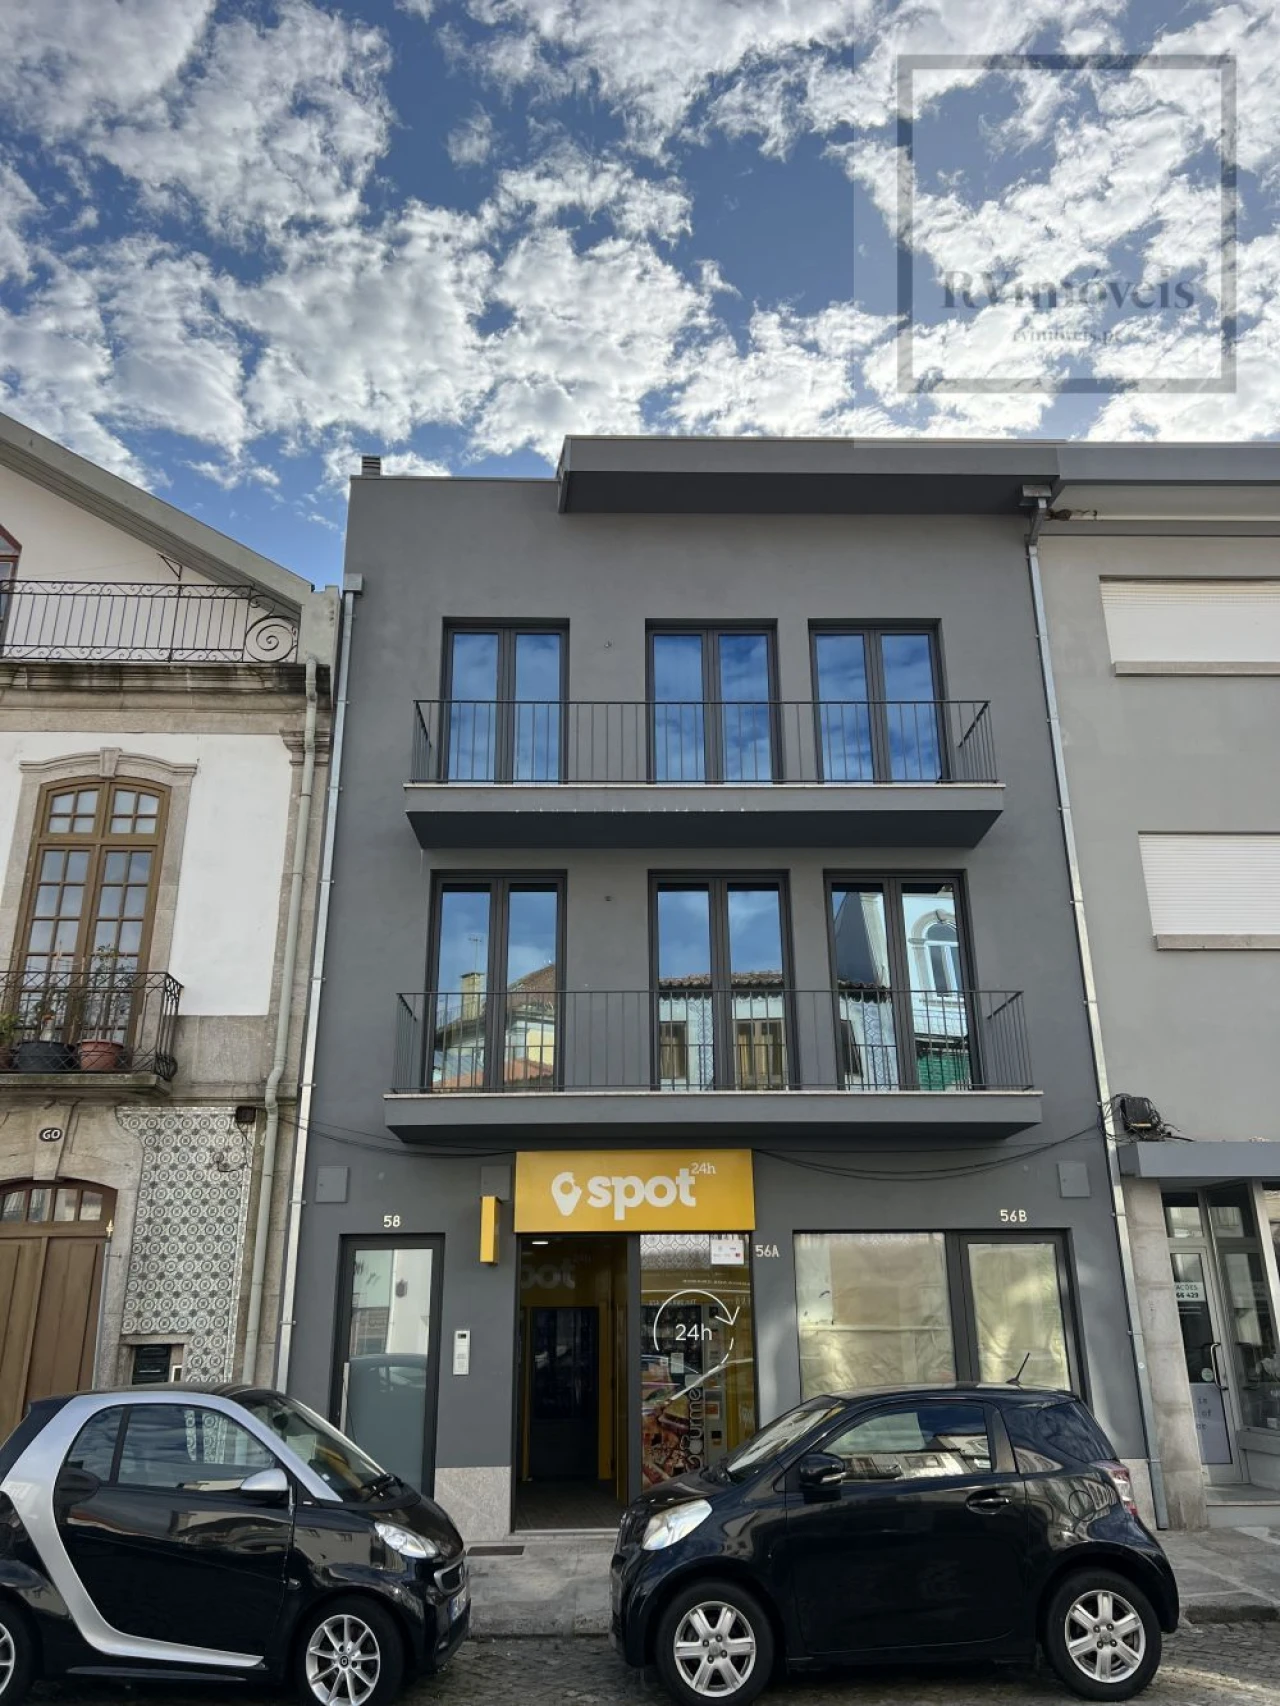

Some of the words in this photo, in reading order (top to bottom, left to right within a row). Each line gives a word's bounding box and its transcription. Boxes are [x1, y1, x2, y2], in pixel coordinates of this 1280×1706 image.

[691, 1162, 717, 1175] 24h
[587, 1168, 696, 1221] spot
[383, 1215, 401, 1228] 58
[1000, 1209, 1028, 1222] 56B
[755, 1245, 780, 1258] 56A
[675, 1324, 713, 1341] 24h
